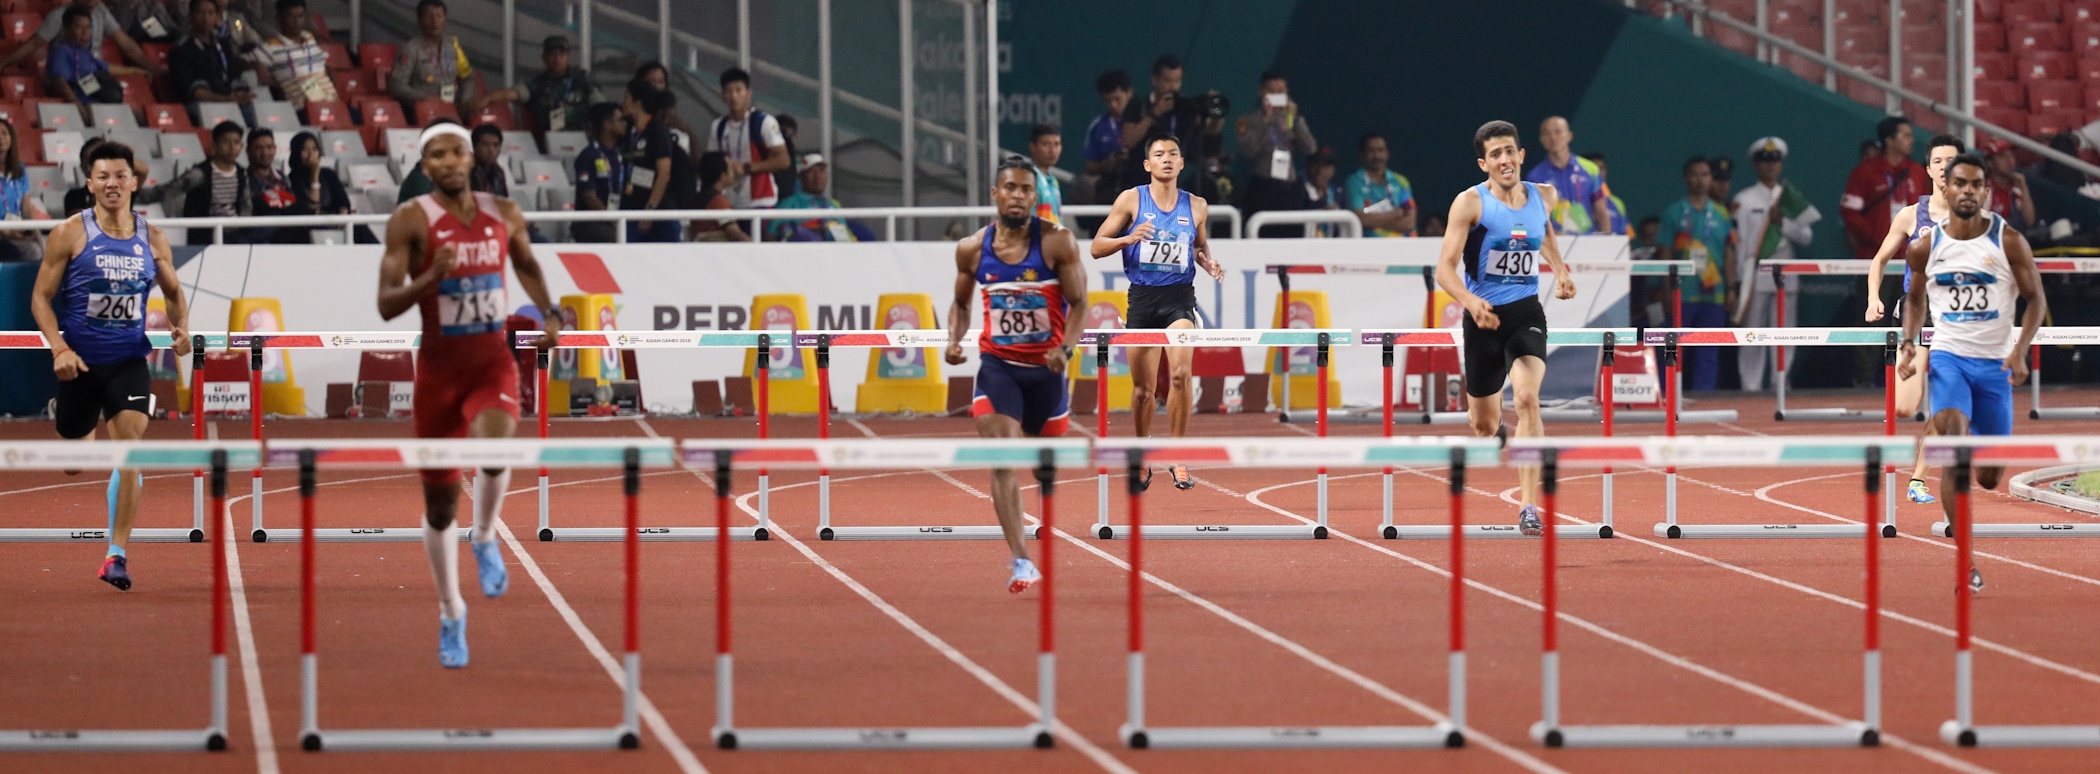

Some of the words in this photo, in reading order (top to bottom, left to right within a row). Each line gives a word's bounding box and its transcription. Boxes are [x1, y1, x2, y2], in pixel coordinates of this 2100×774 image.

[95, 254, 145, 271] CHINESE
[1149, 241, 1182, 265] 792
[1495, 251, 1533, 276] 430
[102, 267, 139, 281] TAIPEI
[96, 294, 136, 320] 260
[1948, 286, 1989, 311] 323
[999, 310, 1040, 335] 681
[71, 531, 105, 539] UCS
